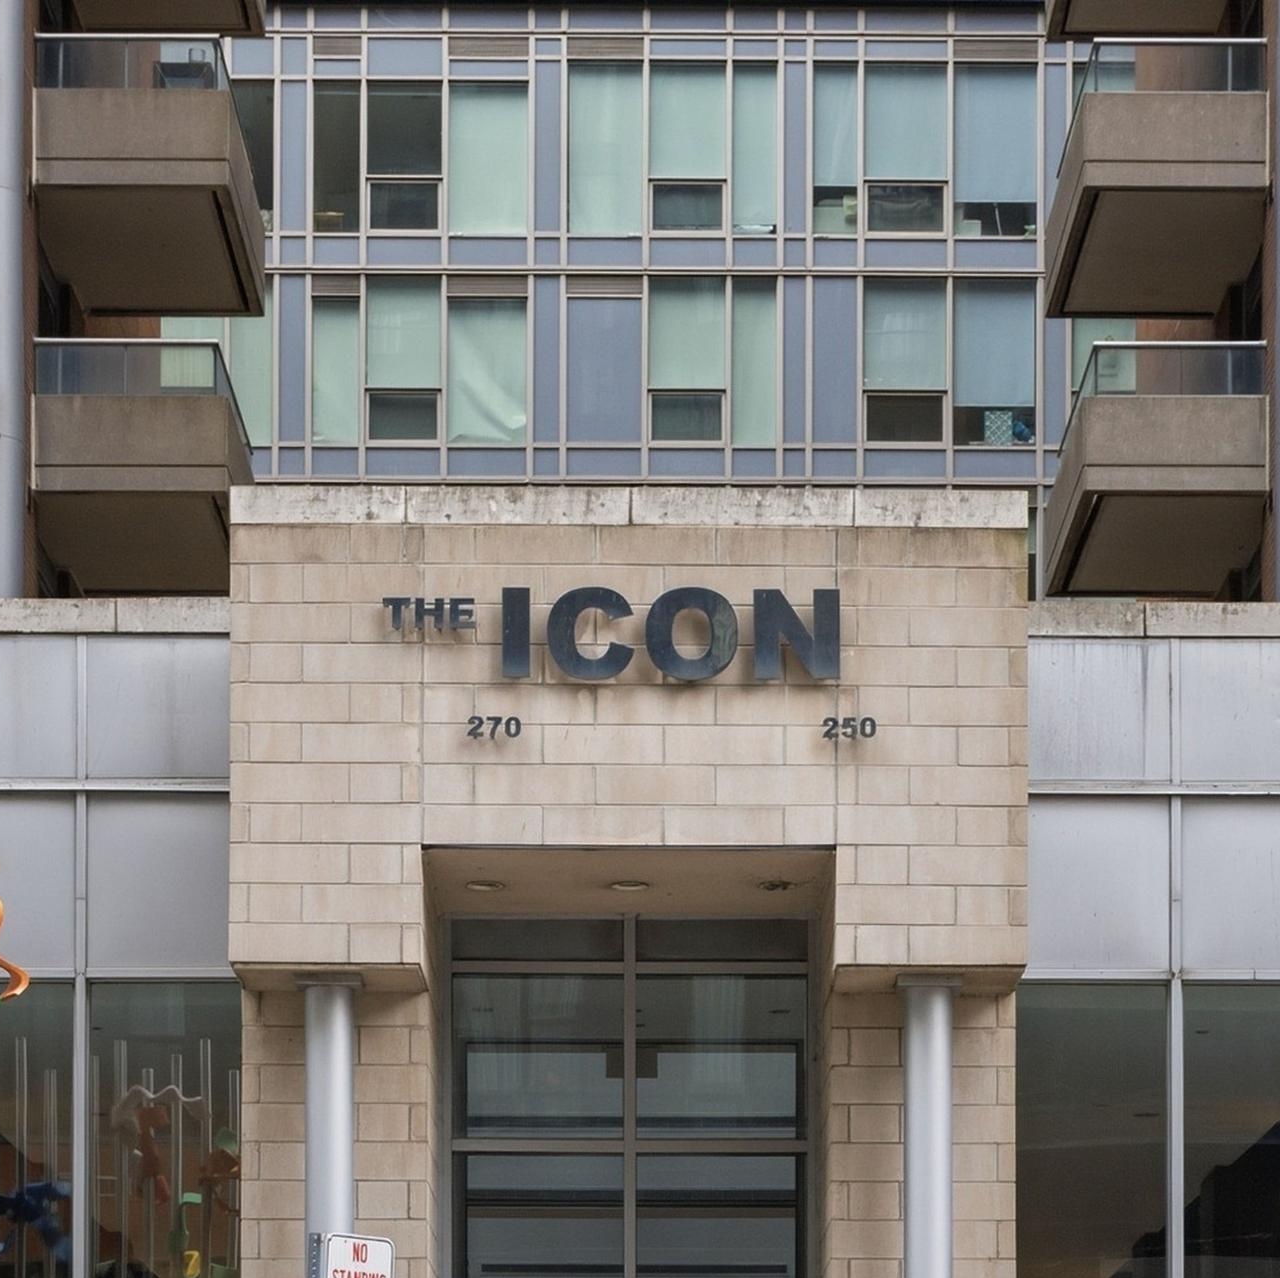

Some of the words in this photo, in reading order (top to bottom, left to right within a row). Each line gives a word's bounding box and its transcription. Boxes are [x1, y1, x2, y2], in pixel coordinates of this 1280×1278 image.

[382, 596, 476, 632] THE
[500, 586, 841, 681] ICON
[467, 715, 522, 740] 270
[822, 716, 877, 740] 250
[352, 1243, 368, 1263] NO
